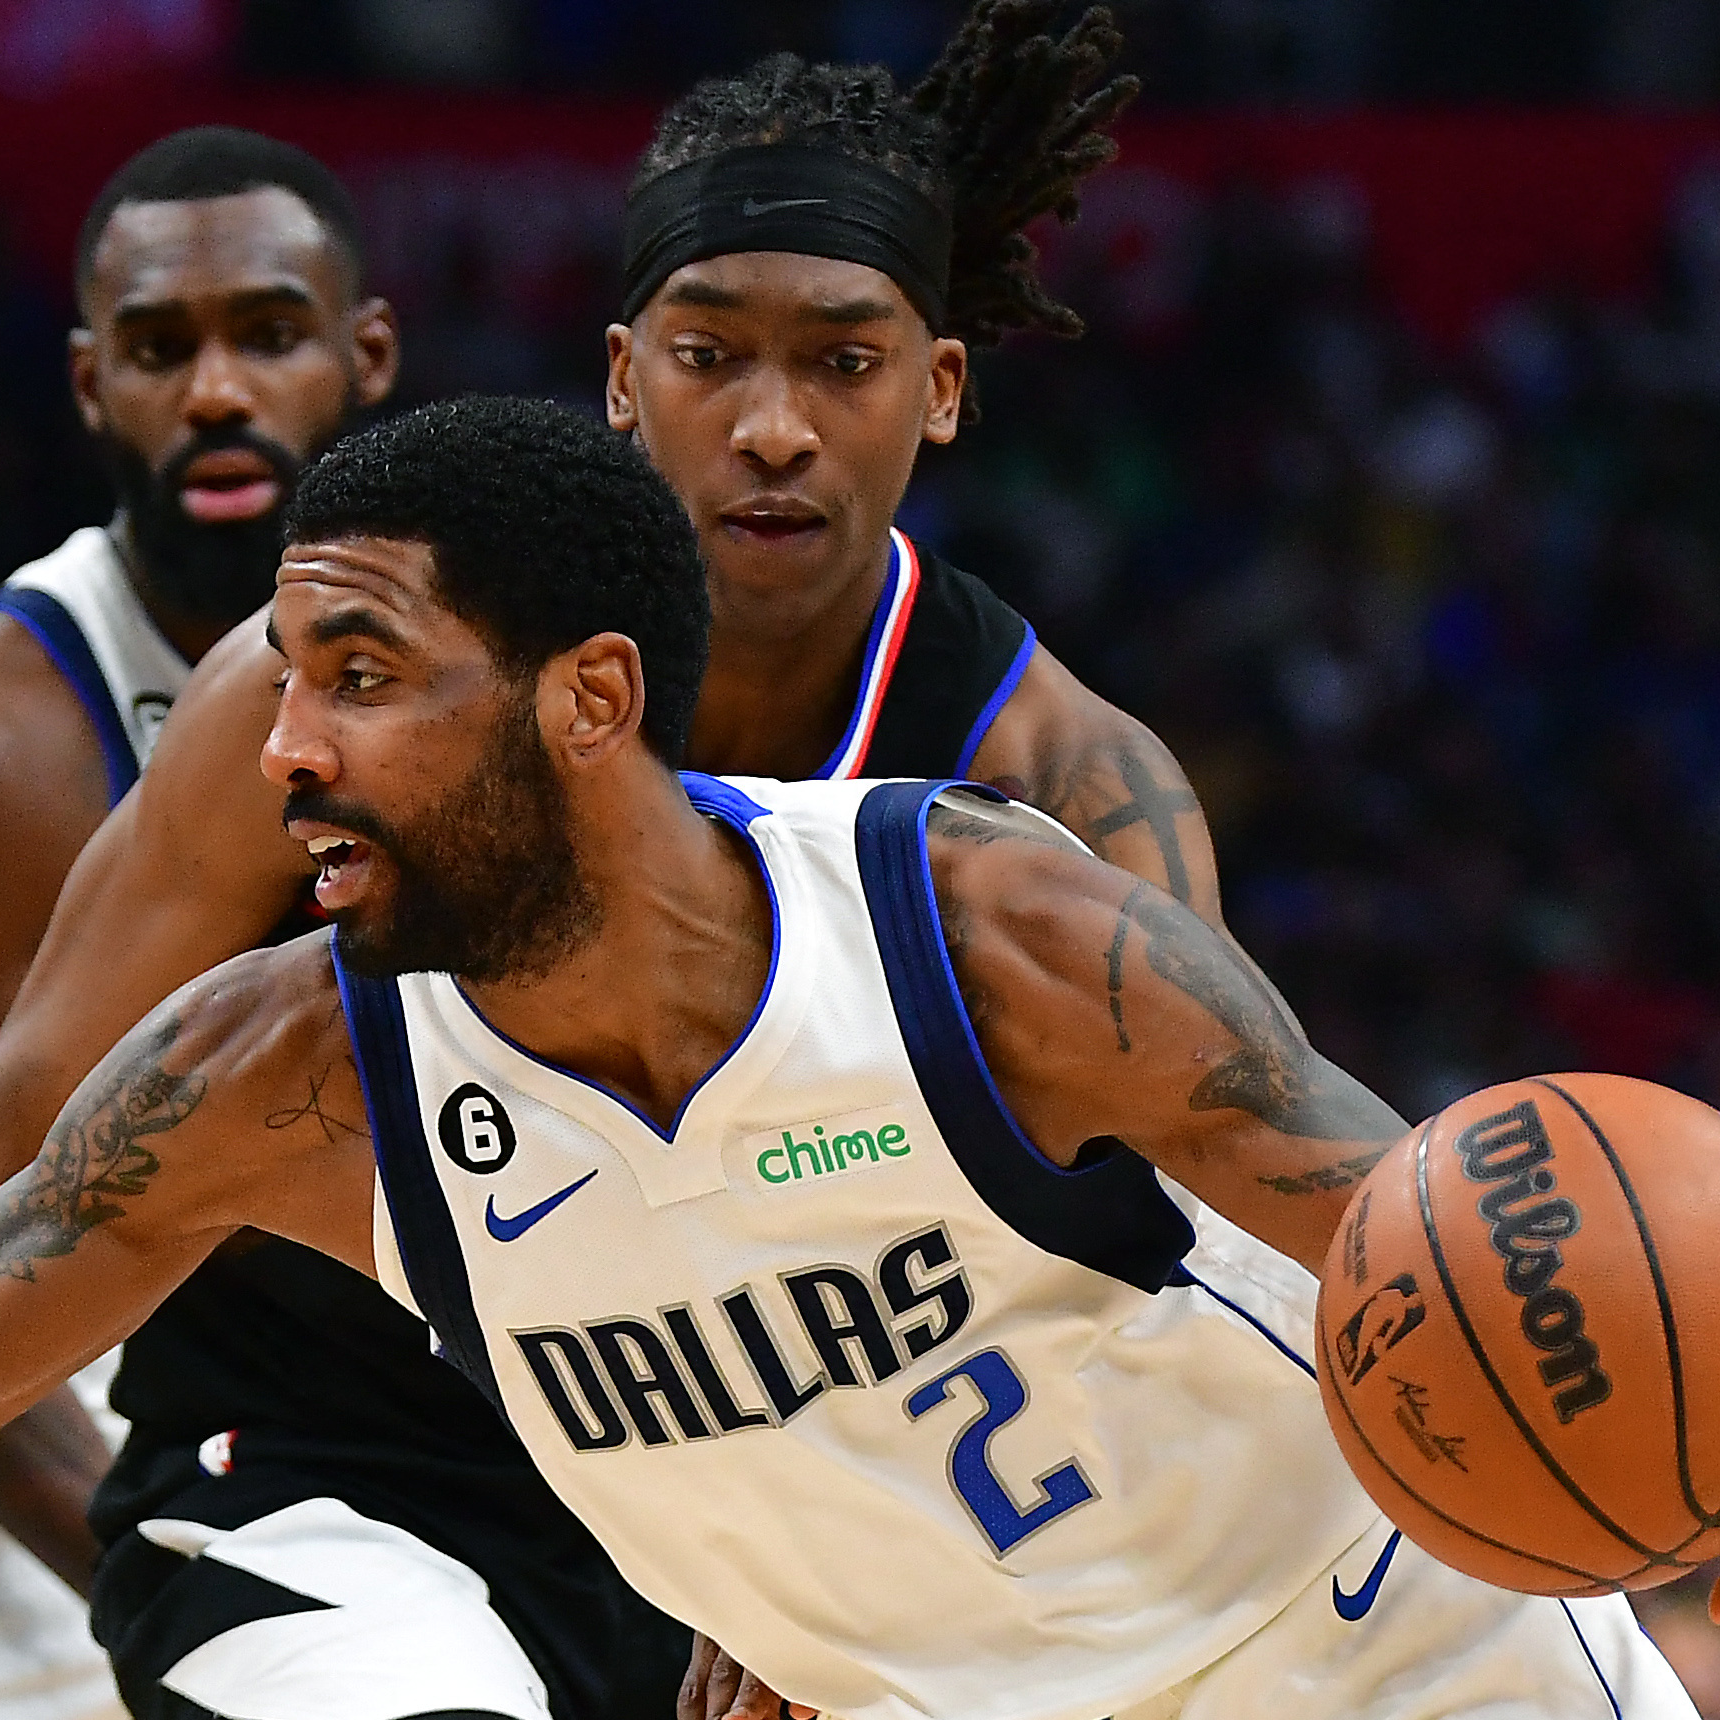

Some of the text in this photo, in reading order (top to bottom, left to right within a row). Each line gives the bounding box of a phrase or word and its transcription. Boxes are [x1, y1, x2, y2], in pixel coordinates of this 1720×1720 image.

[462, 1096, 501, 1163] 6
[756, 1122, 912, 1185] chime
[506, 1219, 975, 1454] DALLAS
[1453, 1098, 1613, 1425] Wilson
[901, 1345, 1102, 1561] 2
